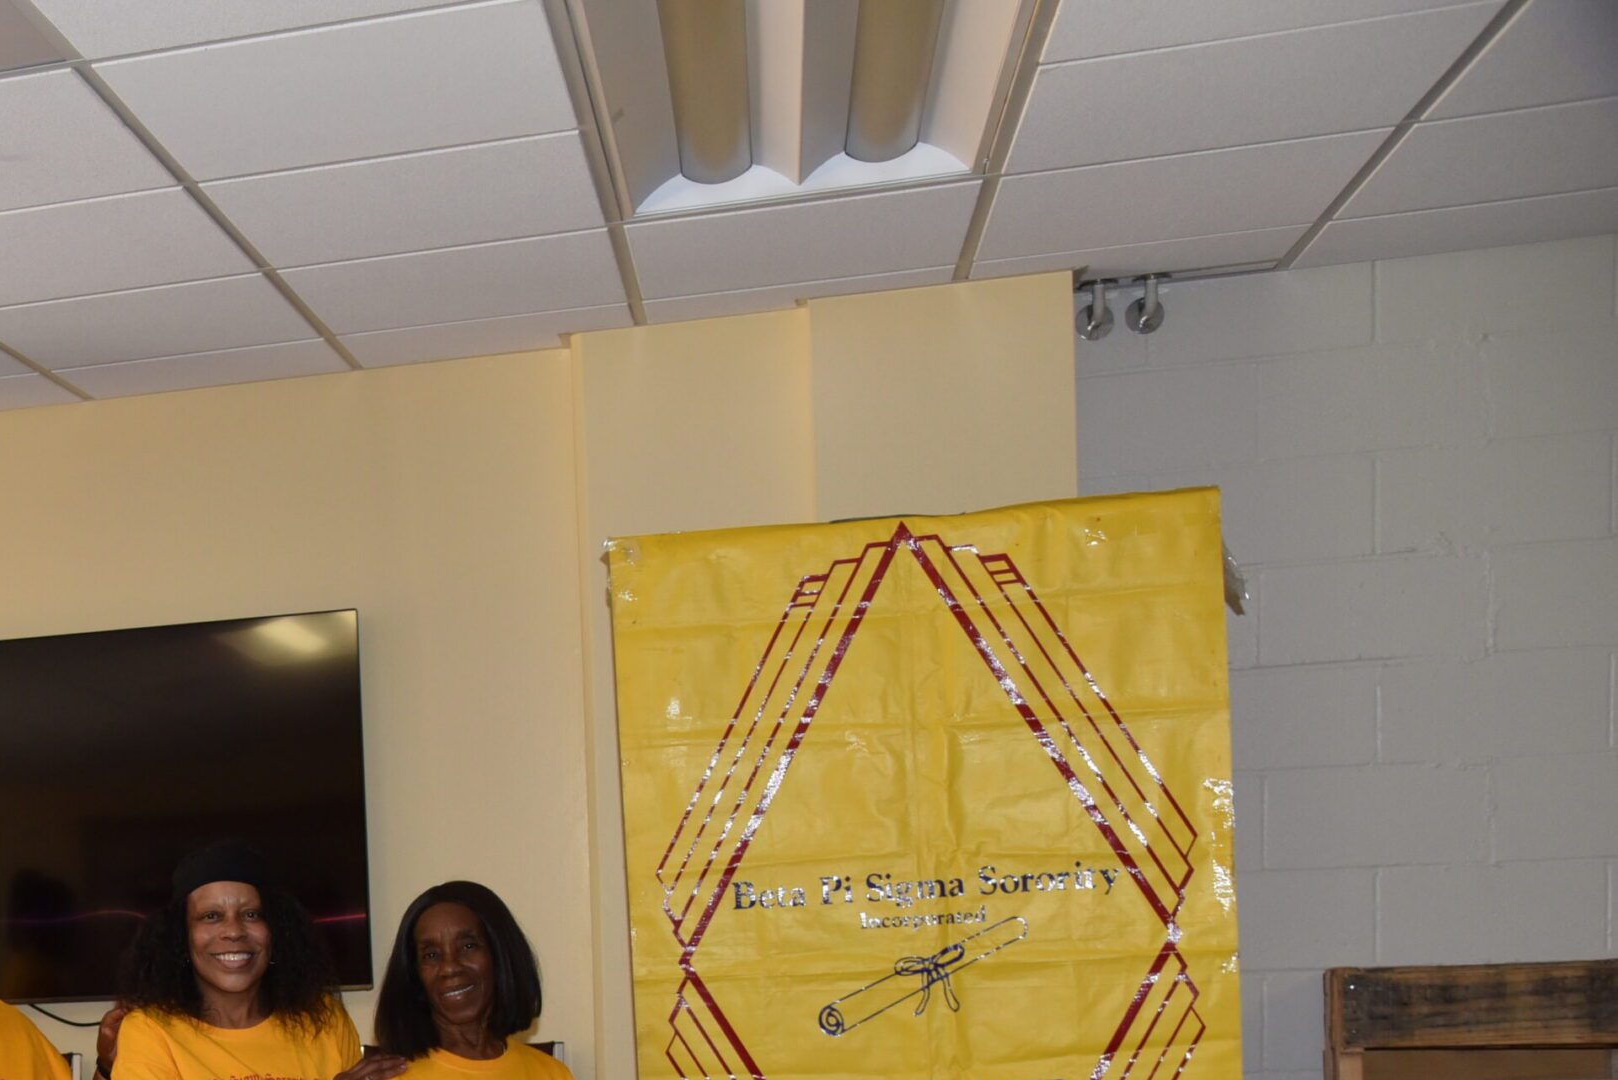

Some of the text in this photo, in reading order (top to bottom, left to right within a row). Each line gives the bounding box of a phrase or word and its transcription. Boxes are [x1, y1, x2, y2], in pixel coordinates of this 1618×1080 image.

[732, 860, 1122, 910] Beta Pi Sigma Sorority
[859, 905, 986, 930] Incorporated
